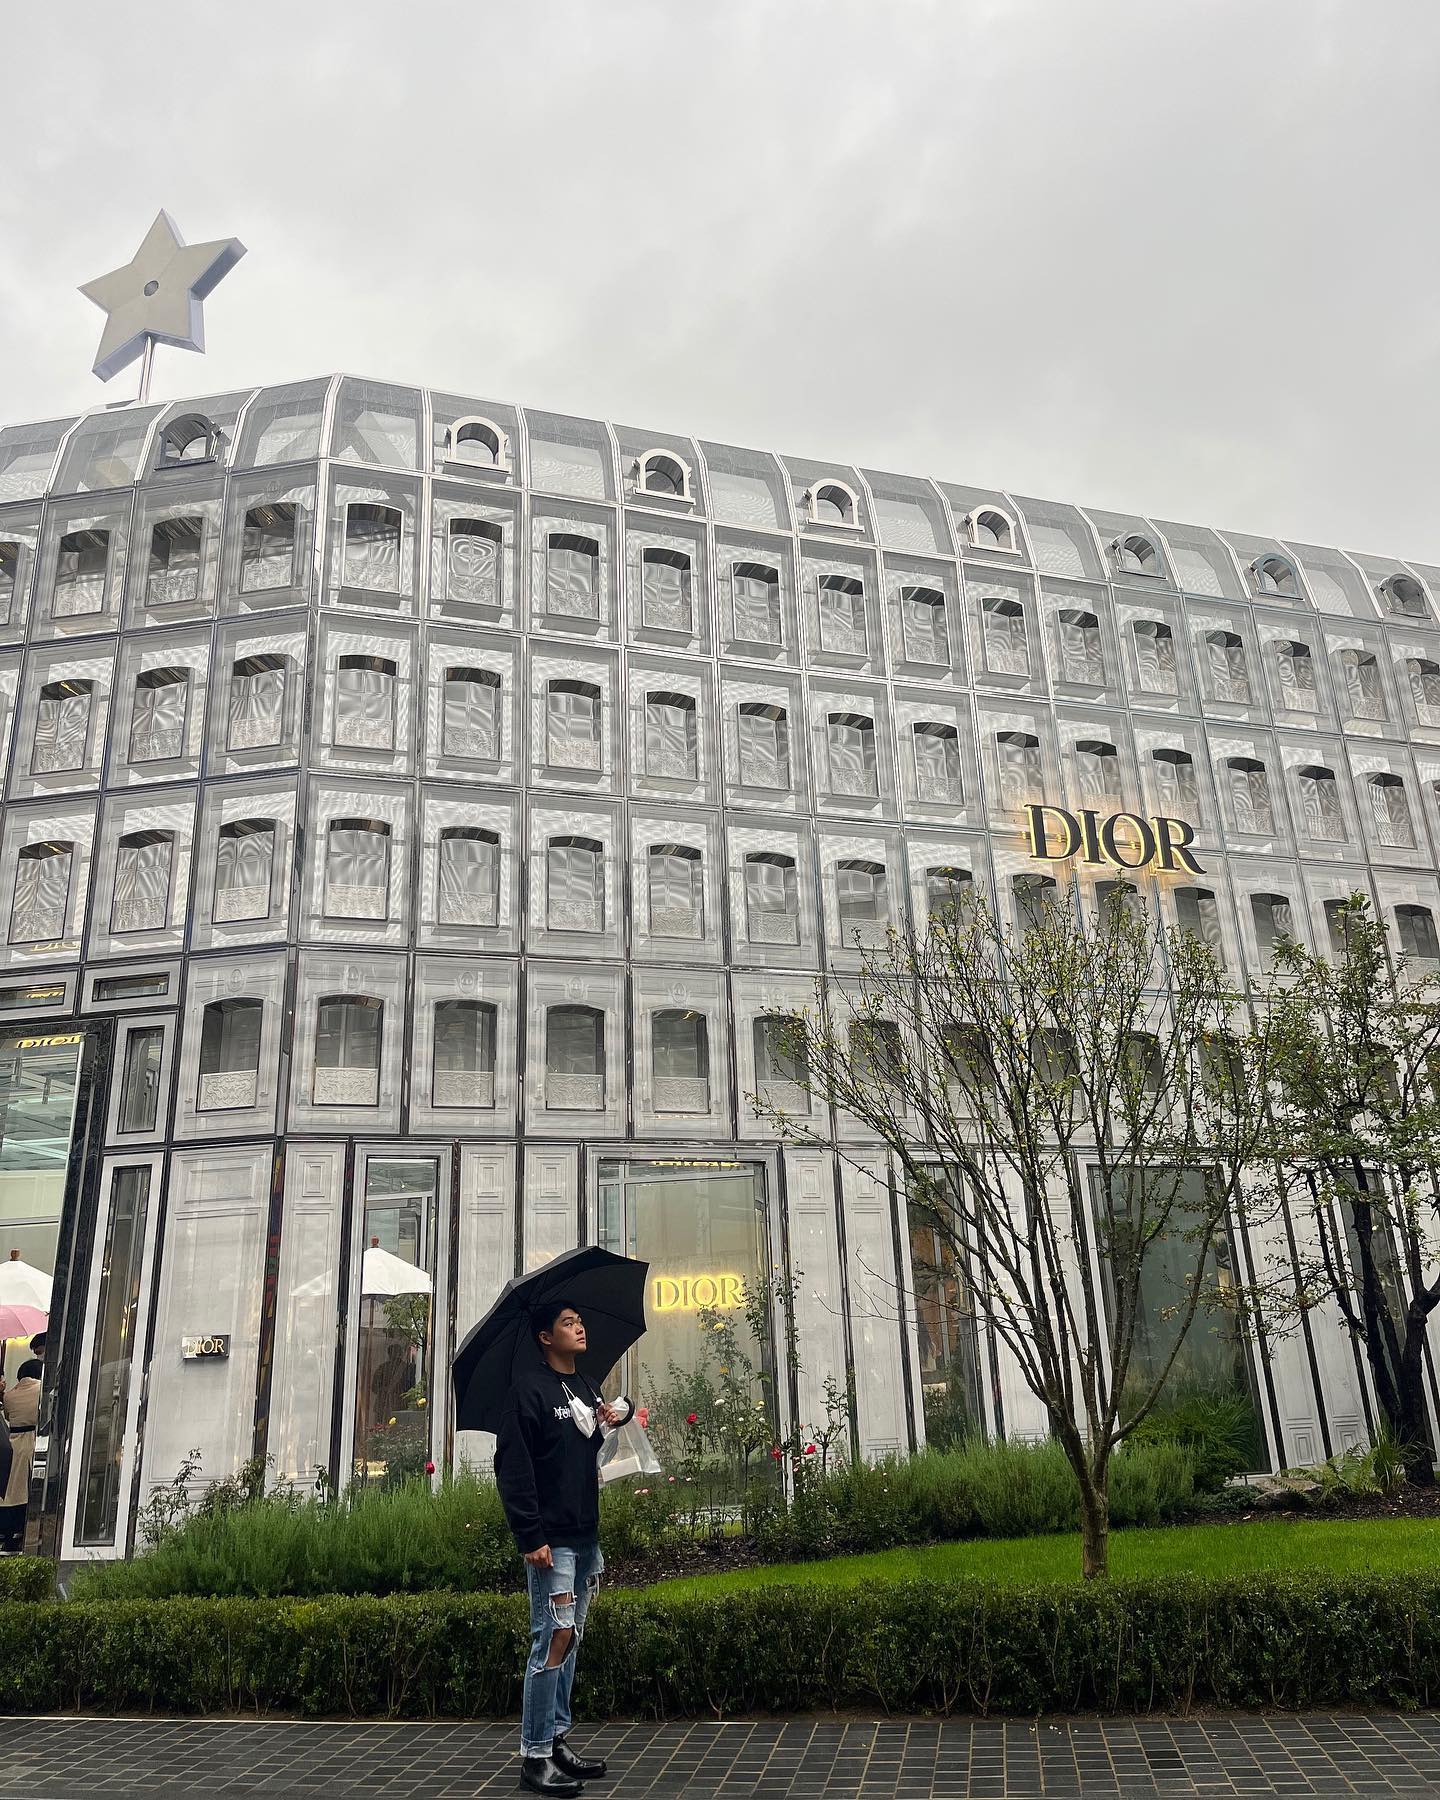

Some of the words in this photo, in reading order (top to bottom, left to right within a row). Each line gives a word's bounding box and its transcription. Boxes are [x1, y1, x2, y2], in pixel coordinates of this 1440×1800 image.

[1024, 803, 1208, 875] DIOR
[653, 1275, 745, 1309] DIOR
[185, 1338, 225, 1355] DIOR
